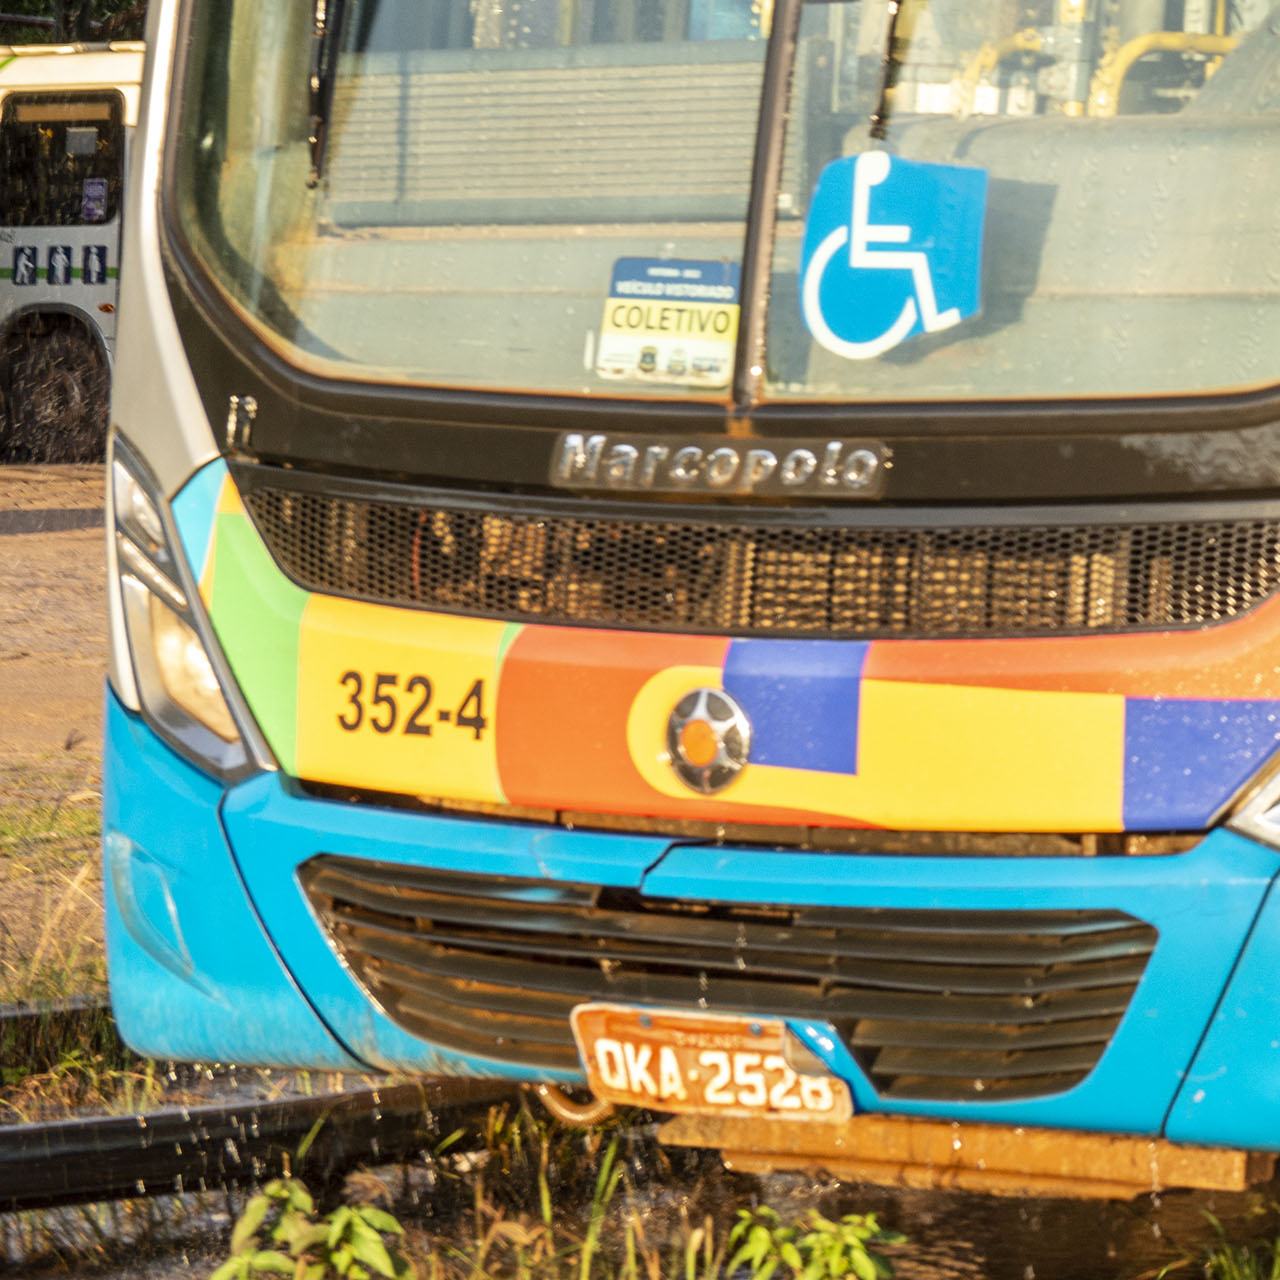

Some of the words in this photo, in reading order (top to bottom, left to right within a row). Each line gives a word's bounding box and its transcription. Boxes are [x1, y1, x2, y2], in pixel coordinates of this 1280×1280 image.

[611, 304, 731, 334] COLETIVO
[557, 432, 880, 494] Marcopolo
[337, 670, 488, 741] 352-4
